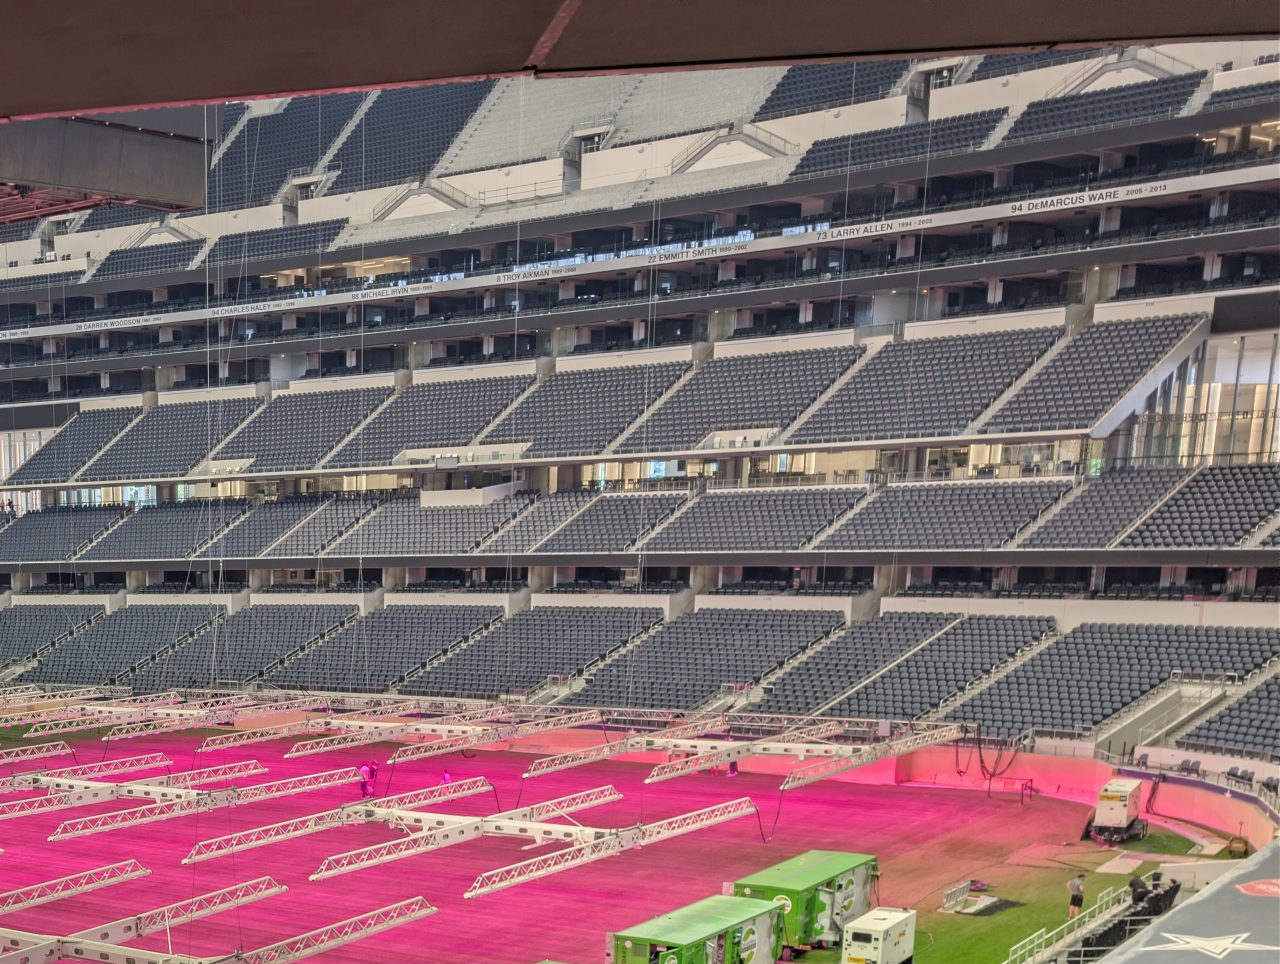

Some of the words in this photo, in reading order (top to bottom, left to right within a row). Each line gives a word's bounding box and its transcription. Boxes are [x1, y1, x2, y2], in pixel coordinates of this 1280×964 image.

[1011, 204, 1023, 213] 94
[1088, 190, 1120, 202] WARE
[1149, 185, 1167, 193] 2013
[816, 232, 828, 240] 73
[830, 227, 861, 238] LARRY
[862, 223, 893, 236] ALLEN
[659, 251, 690, 262] EMMITT
[692, 247, 717, 257] SMITH
[503, 273, 523, 281] TROY
[522, 269, 550, 279] AIKMAN
[361, 290, 390, 299] MICHAEL
[390, 287, 409, 295] IRVIN
[220, 306, 250, 315] CHARLES
[250, 303, 271, 312] HALEY
[83, 322, 108, 330] DARREN
[110, 318, 141, 327] WOODSON
